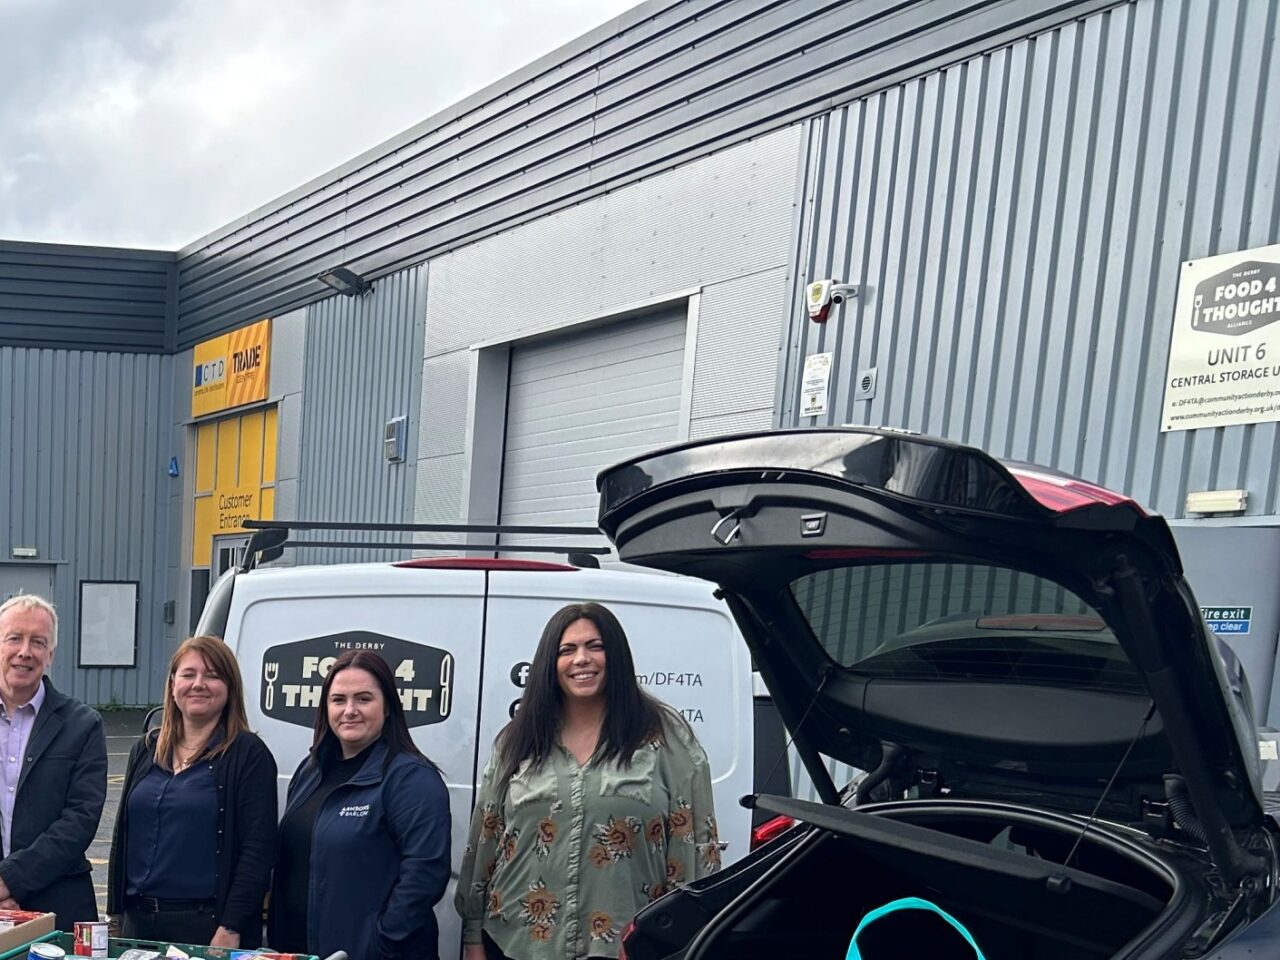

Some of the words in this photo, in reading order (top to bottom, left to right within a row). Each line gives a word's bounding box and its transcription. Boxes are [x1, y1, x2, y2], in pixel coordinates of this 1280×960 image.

[1215, 280, 1263, 301] FOOD
[1265, 276, 1276, 293] 4
[233, 345, 261, 374] TRADE
[1207, 345, 1252, 366] UNIT
[1255, 343, 1267, 360] 6
[1171, 374, 1217, 389] CENTRAL
[1219, 366, 1270, 383] STORAGE
[218, 493, 254, 512] Customer
[1222, 608, 1245, 619] exit
[1221, 622, 1243, 631] clear
[334, 641, 352, 650] THE
[355, 642, 386, 651] DERBY
[394, 659, 416, 682] 4
